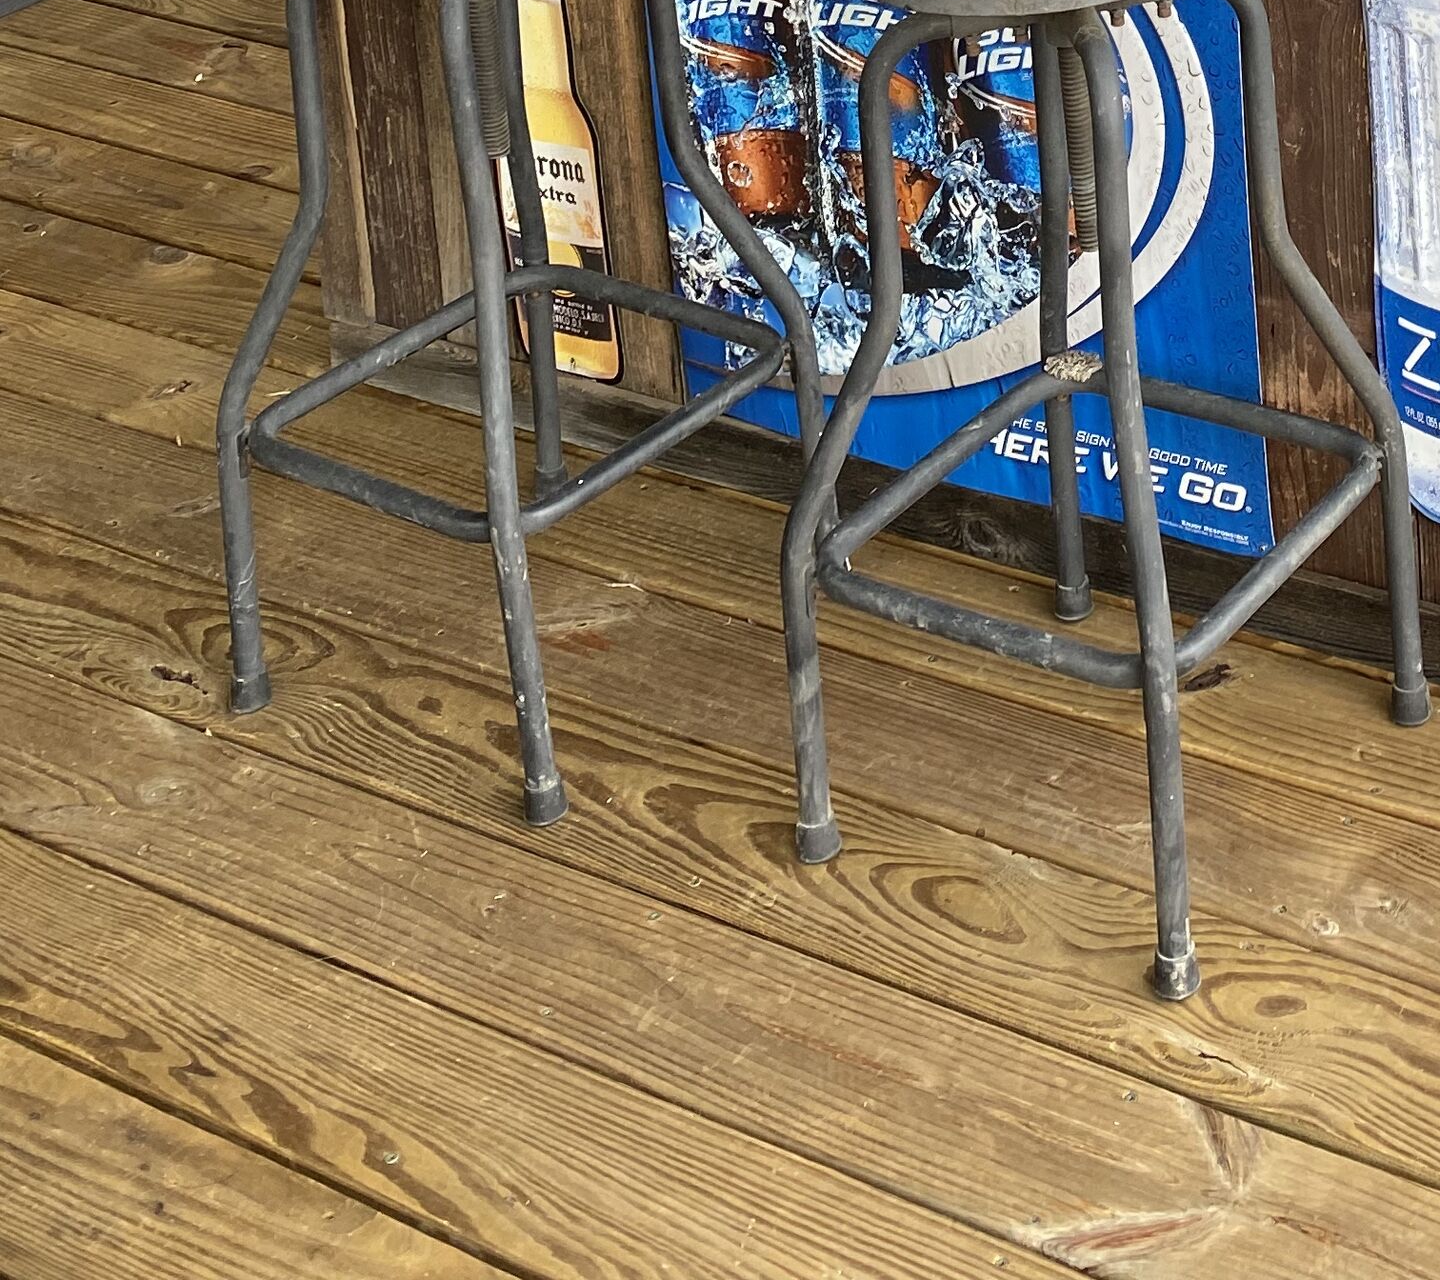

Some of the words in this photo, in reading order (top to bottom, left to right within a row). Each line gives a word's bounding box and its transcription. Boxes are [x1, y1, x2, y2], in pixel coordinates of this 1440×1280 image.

[811, 2, 900, 31] LIGH
[958, 46, 1033, 81] LIG
[536, 155, 586, 184] rona
[539, 186, 577, 205] xtra
[1012, 417, 1032, 430] HE
[1075, 430, 1111, 447] SIGN
[1148, 447, 1191, 467] GOOD
[1194, 457, 1228, 476] TIME
[1178, 471, 1247, 512] GO
